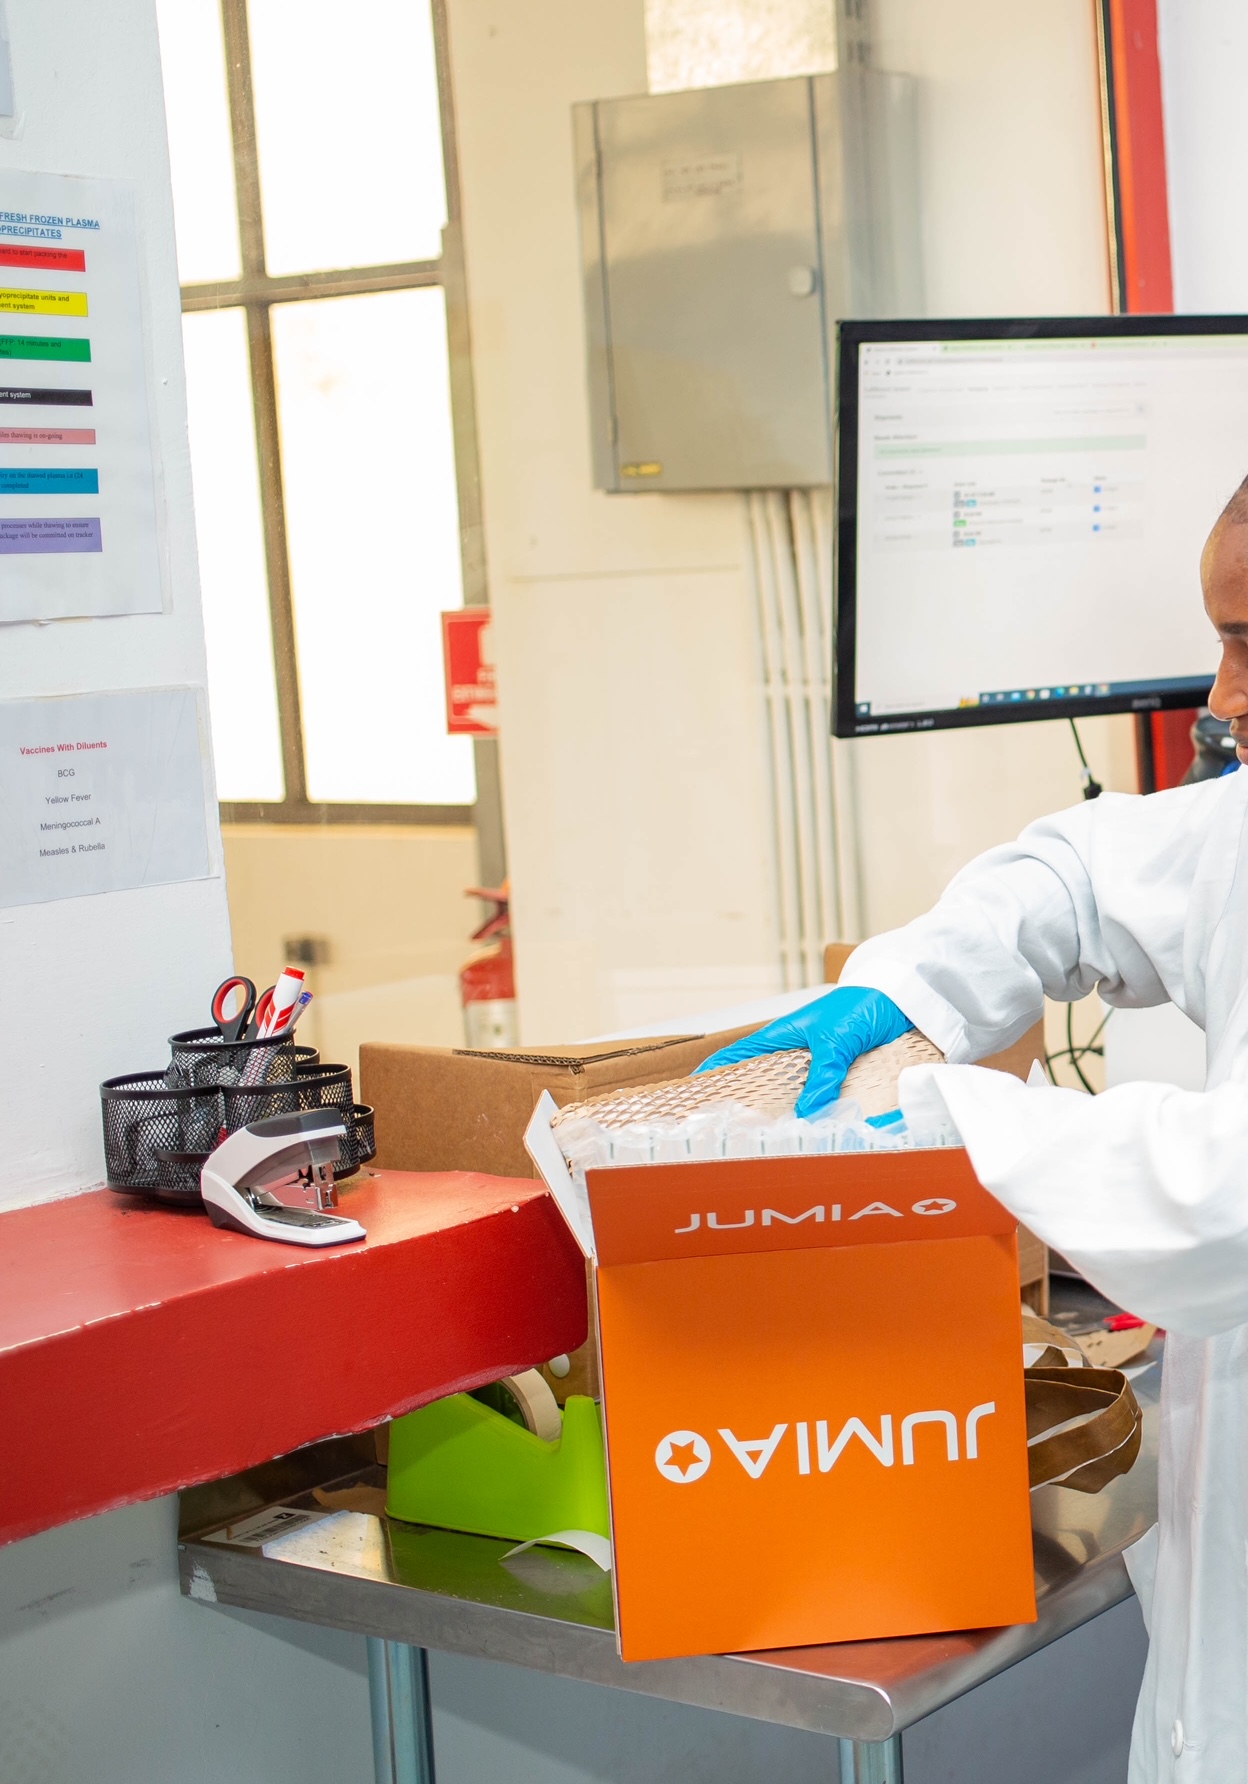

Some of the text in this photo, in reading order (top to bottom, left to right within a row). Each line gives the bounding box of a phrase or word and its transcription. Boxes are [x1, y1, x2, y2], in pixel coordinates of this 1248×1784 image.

[0, 212, 100, 228] FRESH FROZEN PLASMA
[0, 225, 62, 238] PRECIPITATES
[10, 391, 31, 399] system
[11, 431, 32, 440] thawing
[39, 432, 63, 440] on-going
[47, 472, 66, 480] plasma
[1, 482, 29, 490] completed
[1, 522, 27, 530] processes
[43, 521, 65, 530] thawing
[20, 740, 108, 755] Vaccines With Diluents
[57, 768, 76, 778] BCG
[45, 793, 92, 805] Yellow Fever
[40, 817, 101, 831] Meningococcal A
[39, 842, 106, 857] Measles & Rubella
[674, 1201, 905, 1235] JUMIA
[716, 1400, 996, 1479] JUMIA
